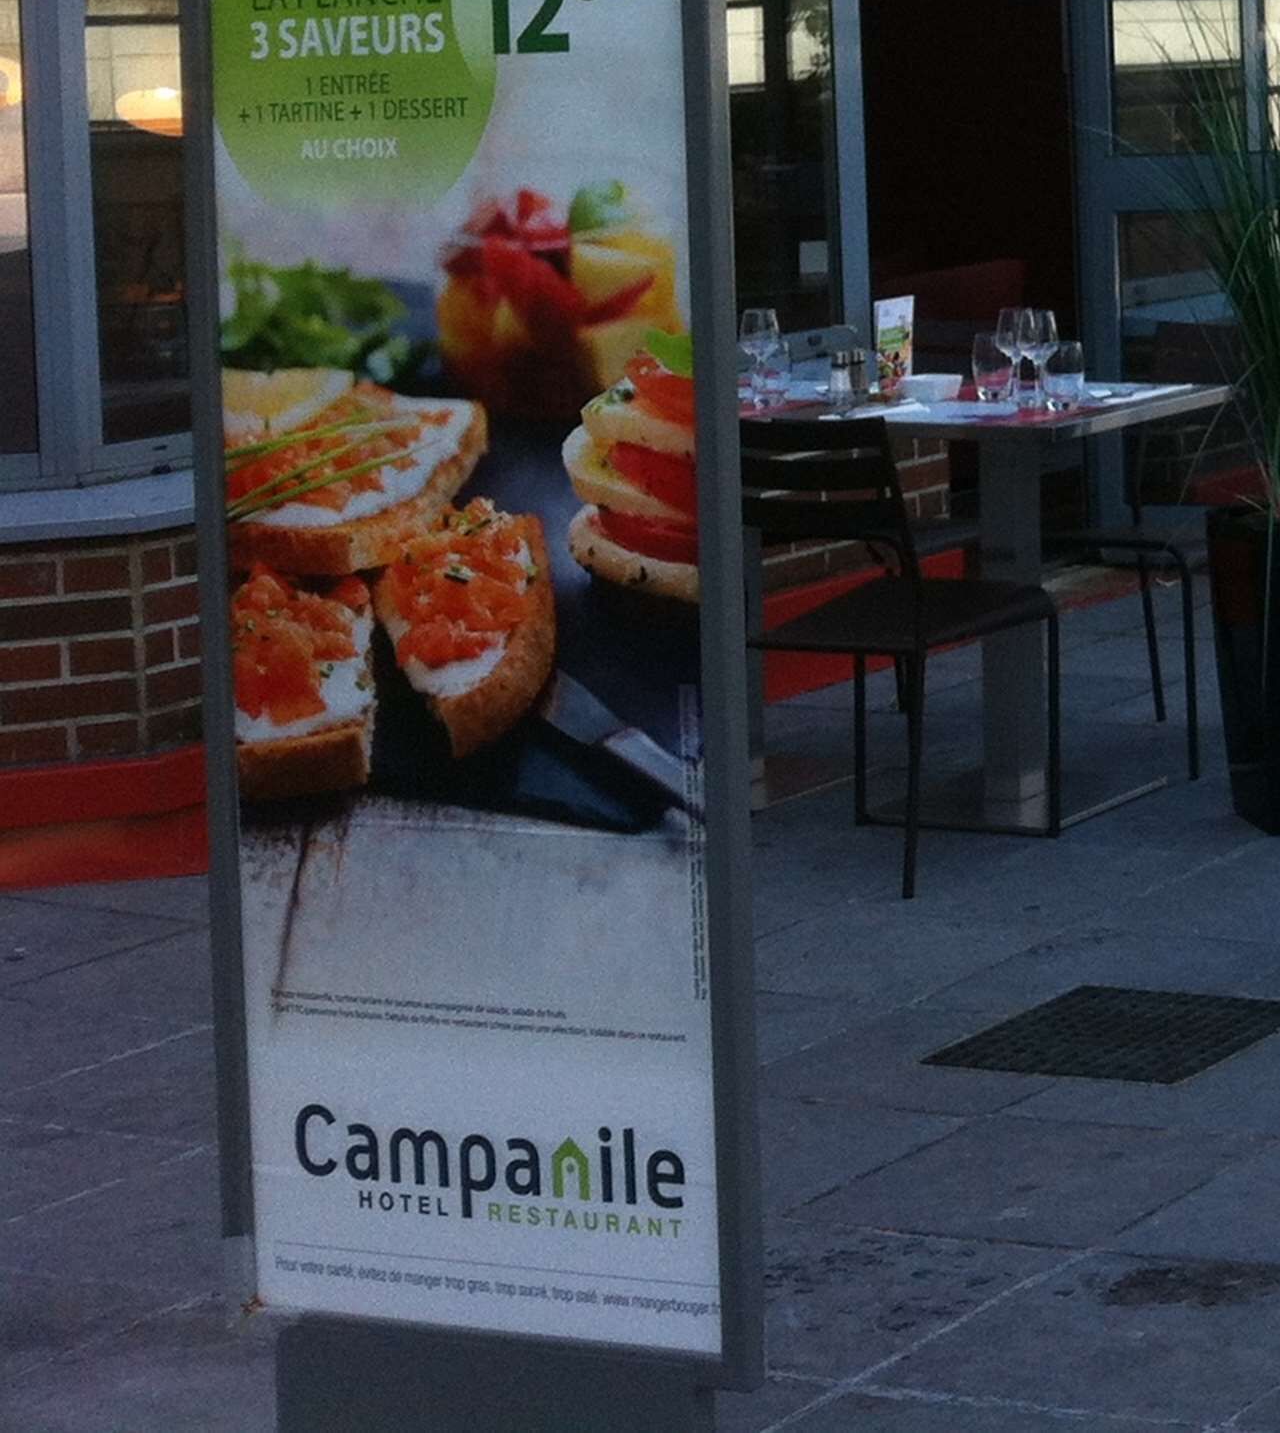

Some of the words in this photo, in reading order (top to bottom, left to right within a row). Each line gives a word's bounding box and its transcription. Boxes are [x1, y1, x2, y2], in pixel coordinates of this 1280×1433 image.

[250, 21, 269, 60] 3
[278, 12, 446, 59] SAVEURS
[305, 77, 313, 96] 1
[320, 70, 391, 95] ENTRÉE
[269, 102, 345, 123] TARTINE
[384, 97, 468, 119] DESSERT
[302, 139, 327, 159] AU
[333, 138, 399, 159] CHOIX
[295, 1103, 686, 1219] Campanile
[359, 1189, 449, 1217] HOTEL
[488, 1203, 684, 1239] RESTAURANT
